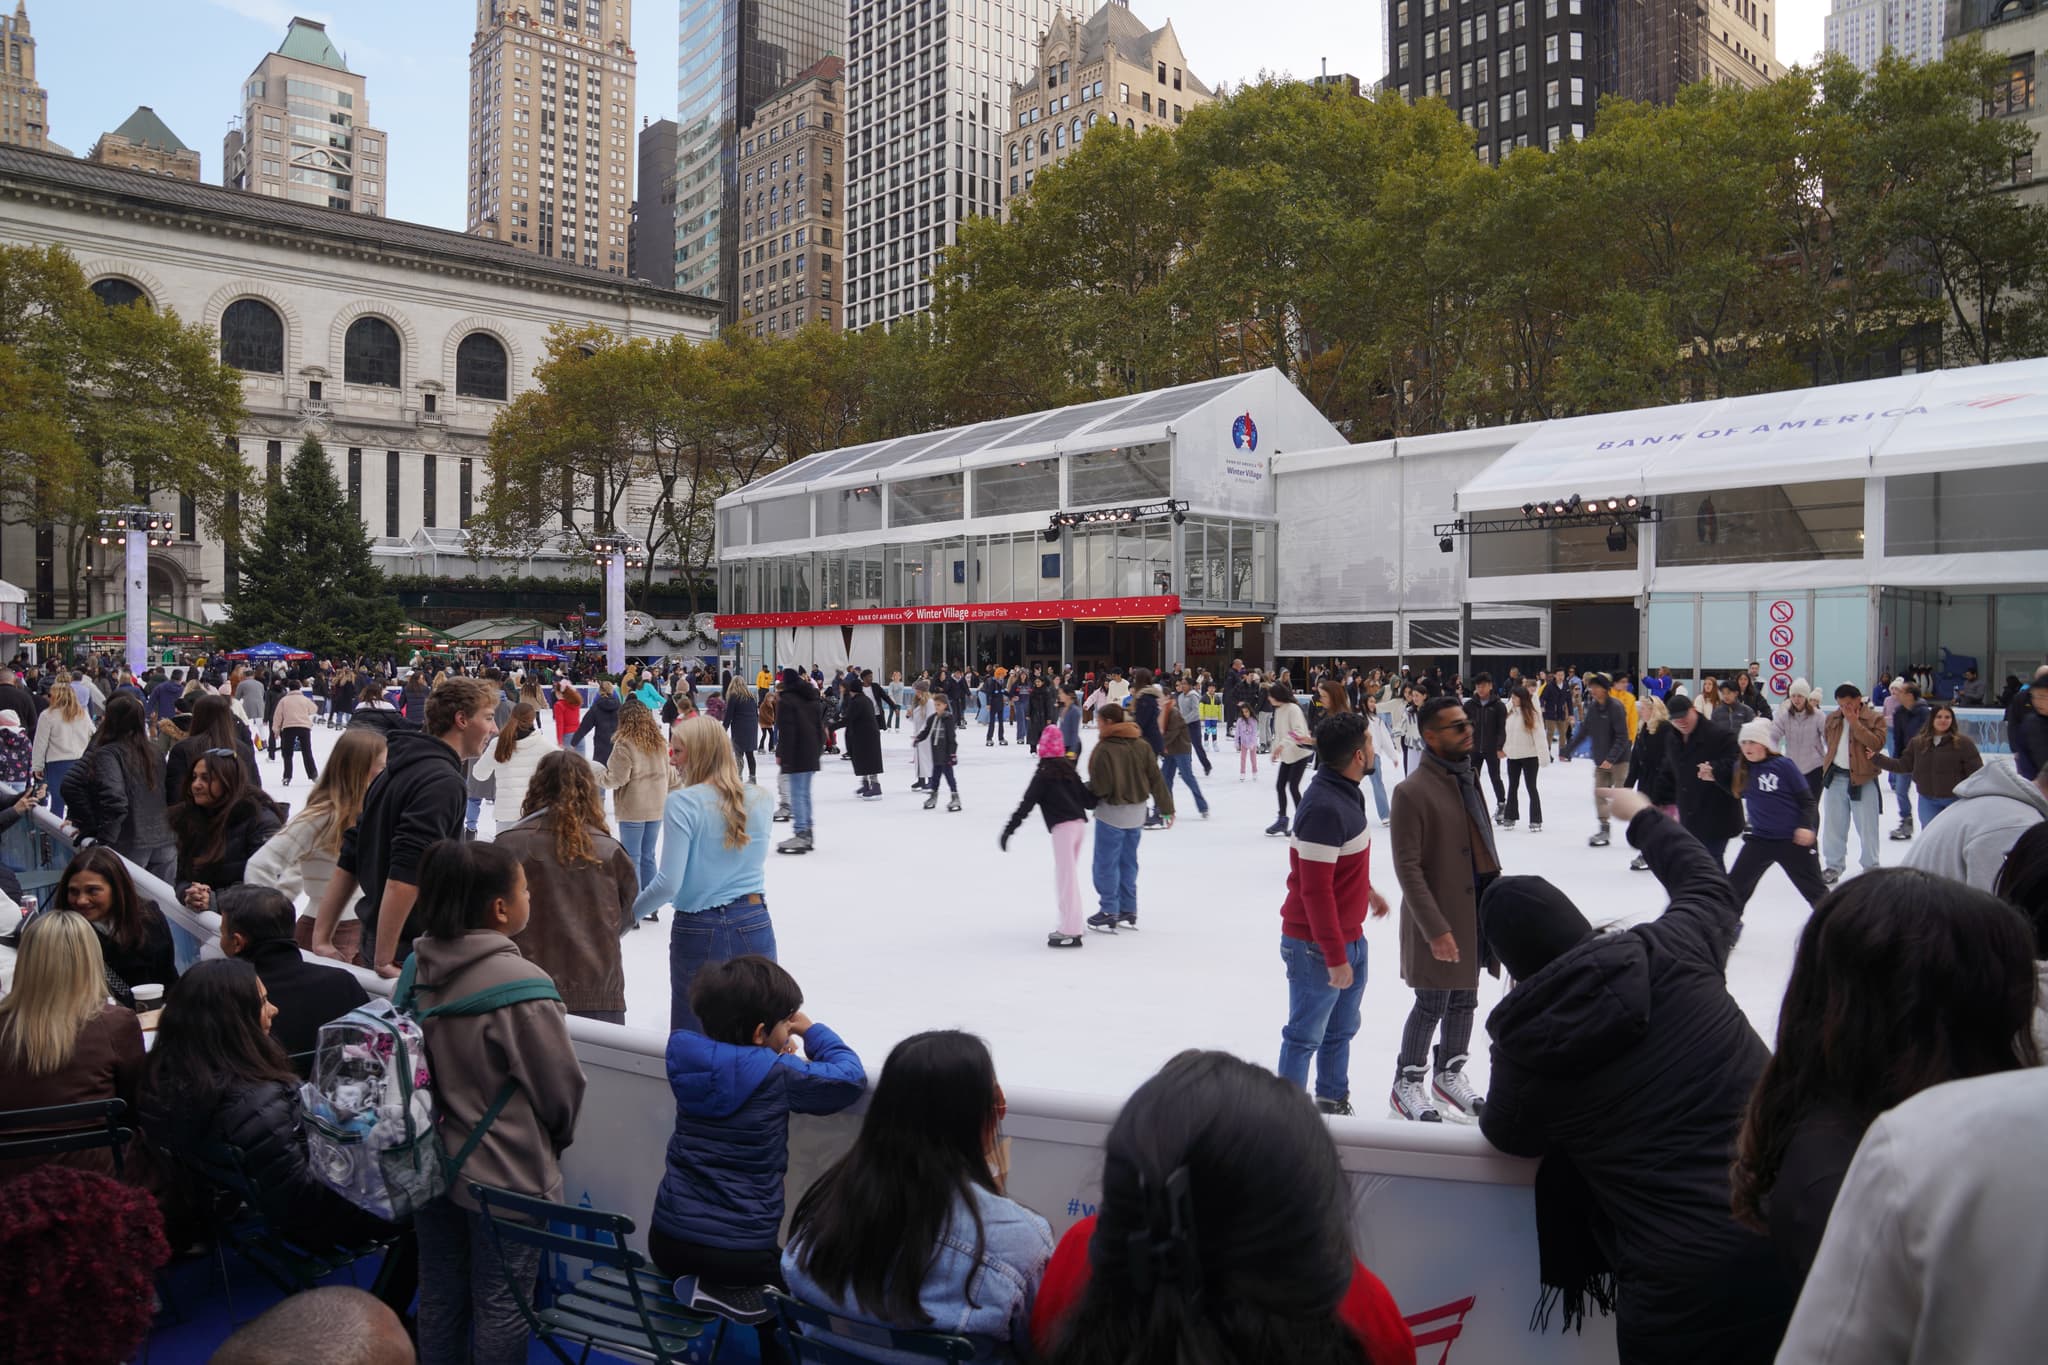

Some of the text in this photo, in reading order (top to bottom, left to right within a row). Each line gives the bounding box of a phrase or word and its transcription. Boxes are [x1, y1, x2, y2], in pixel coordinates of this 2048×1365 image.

[1597, 406, 1928, 450] BANK OF AMERICA
[1227, 467, 1245, 476] Winter
[916, 609, 942, 619] Winter
[942, 608, 968, 621] Village
[978, 609, 995, 619] Bryant
[996, 609, 1008, 617] Park
